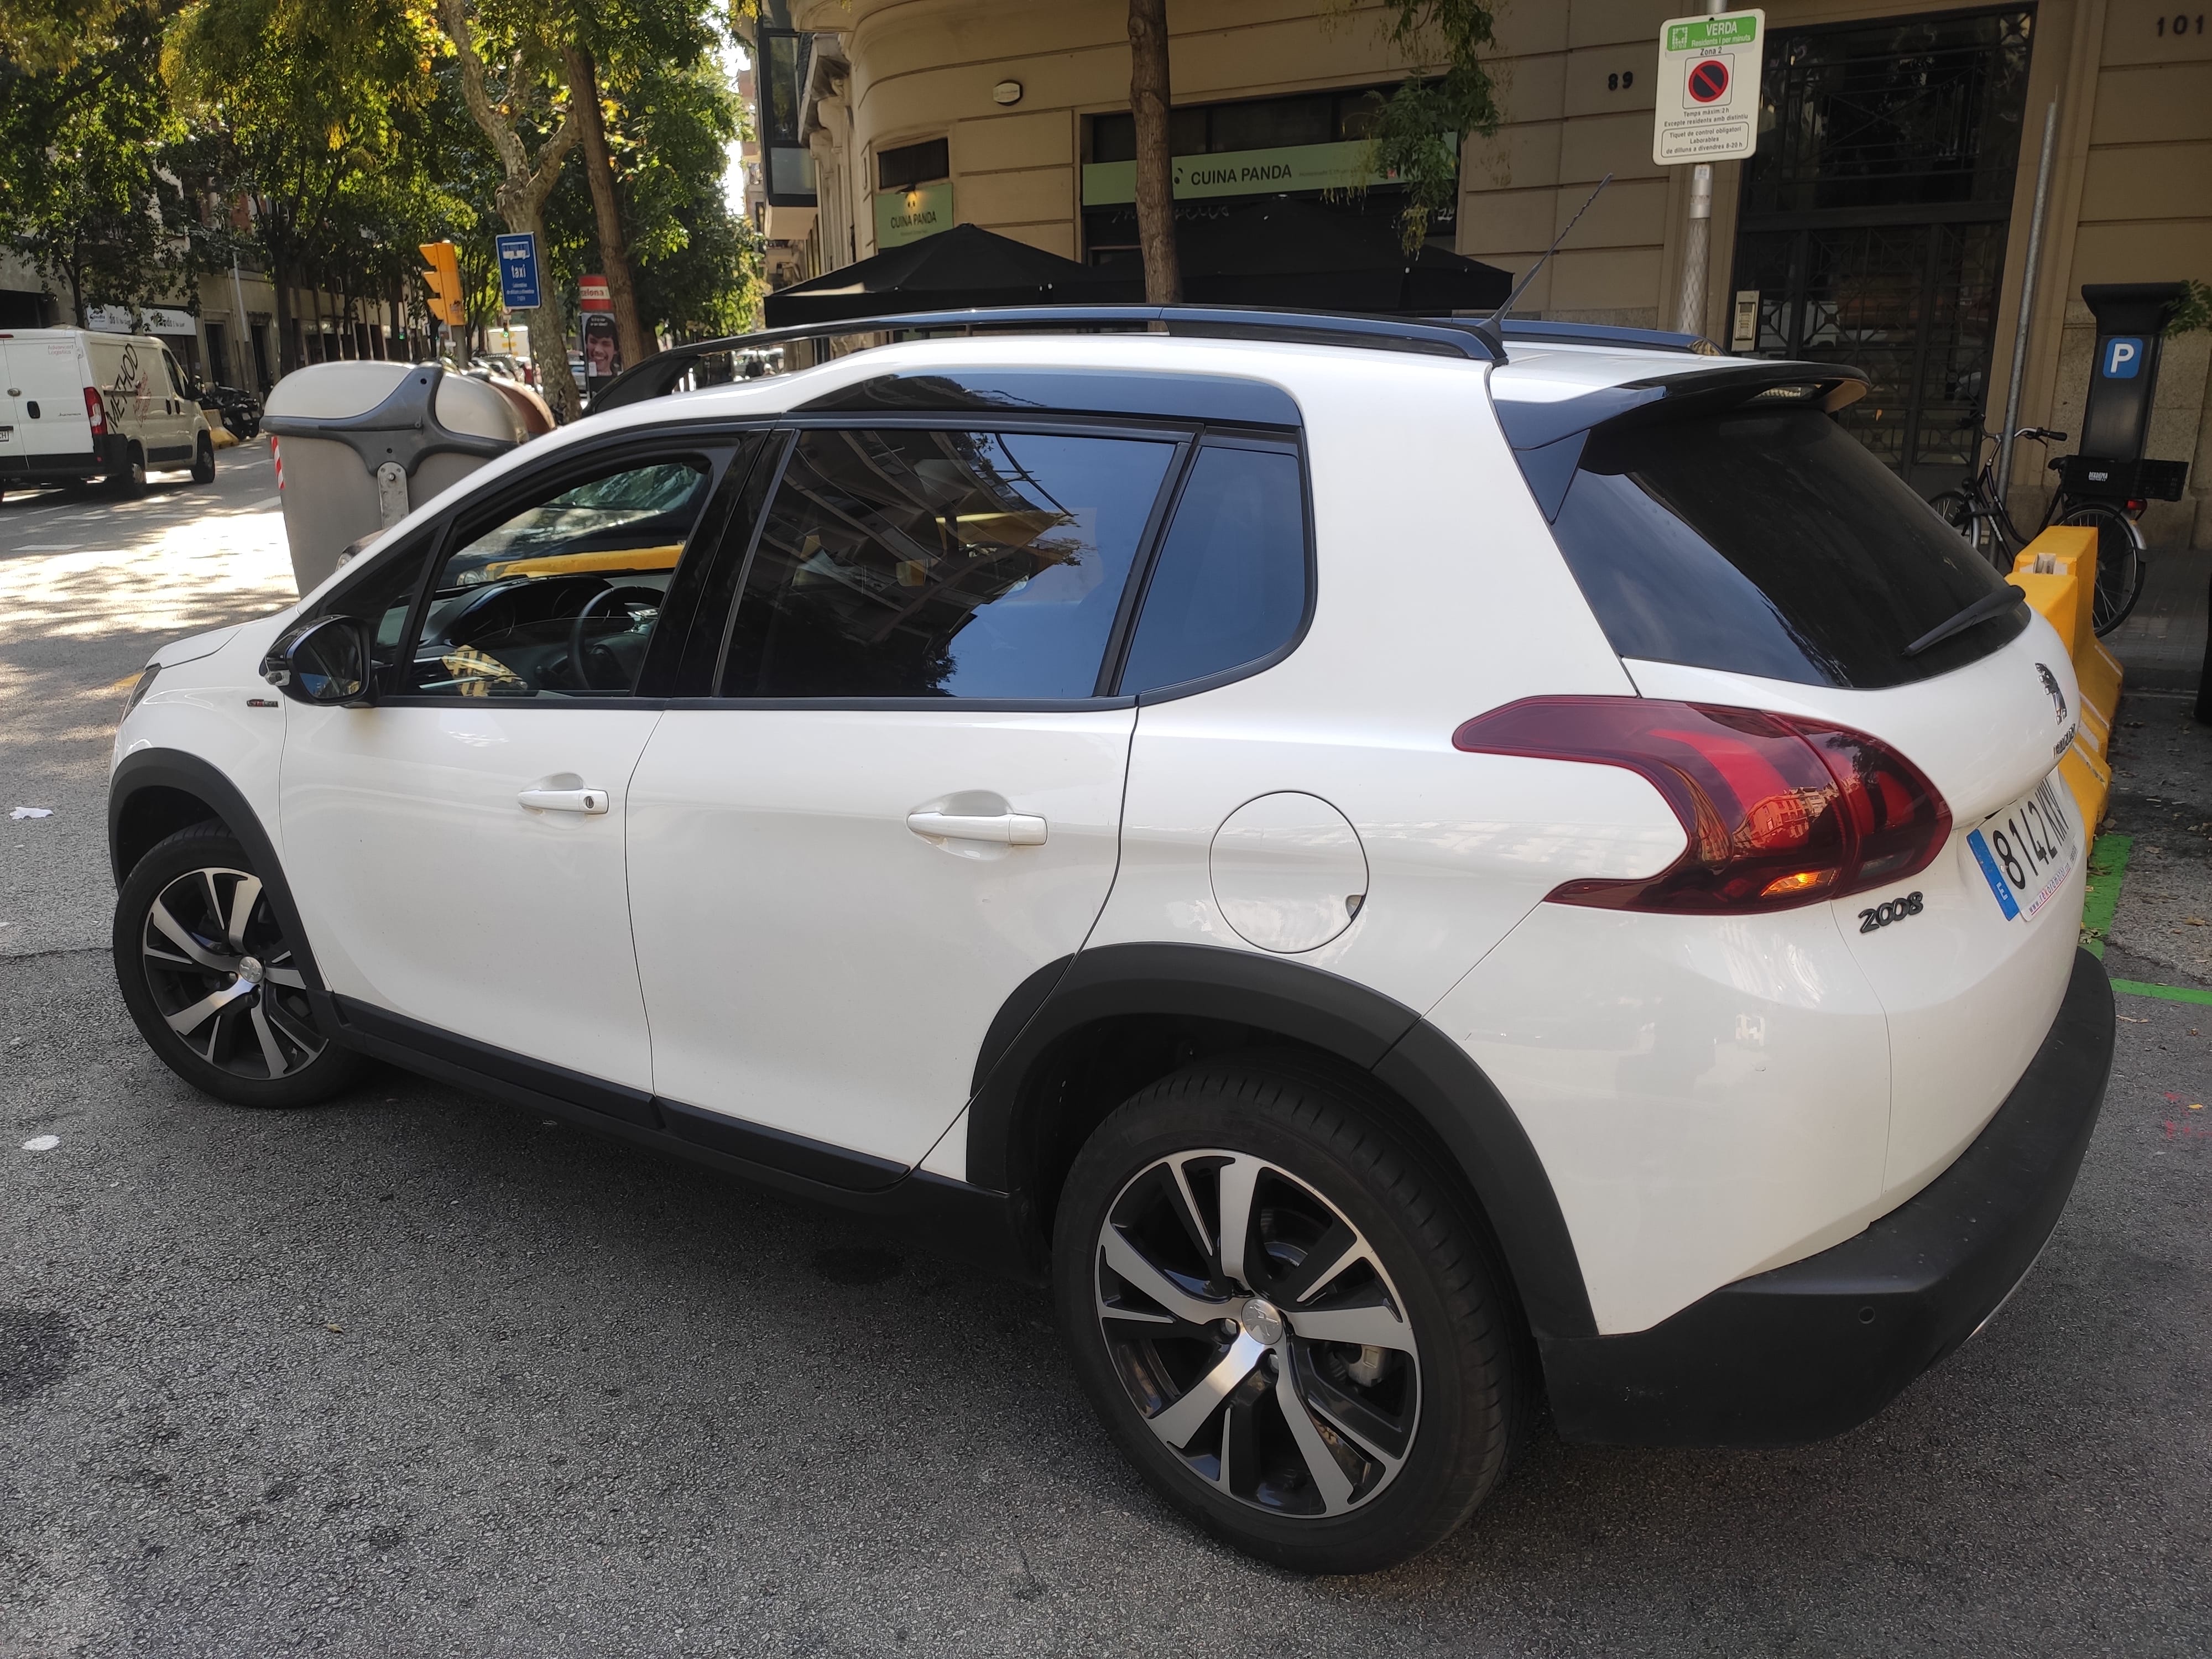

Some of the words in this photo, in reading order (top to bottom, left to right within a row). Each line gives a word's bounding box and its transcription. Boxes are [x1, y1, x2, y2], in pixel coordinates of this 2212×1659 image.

[1706, 21, 1738, 36] VERDA
[2157, 14, 2204, 38] 101
[1692, 39, 1718, 48] Residents
[1732, 34, 1751, 42] minuts
[1608, 71, 1633, 91] 89
[1716, 126, 1741, 134] obligatori
[1191, 168, 1237, 185] CUINA
[1241, 164, 1292, 182] PANDA
[890, 215, 912, 228] CUINA
[913, 210, 937, 225] PANDA
[511, 264, 526, 279] taxi
[2110, 343, 2135, 373] P
[1992, 800, 2058, 890] 8142
[1996, 881, 2008, 900] E
[1858, 891, 1924, 933] 2008
